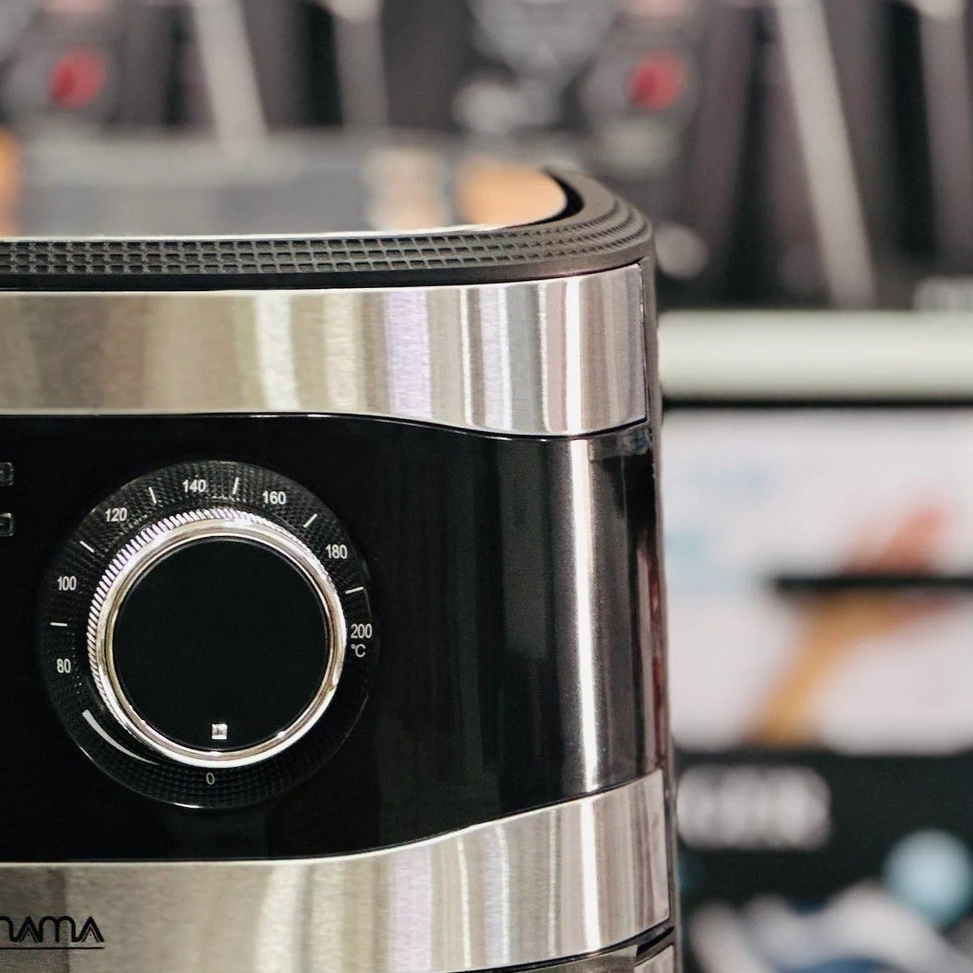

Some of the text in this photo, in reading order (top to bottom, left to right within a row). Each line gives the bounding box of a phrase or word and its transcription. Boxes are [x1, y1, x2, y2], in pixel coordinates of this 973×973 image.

[182, 479, 207, 493] 140
[262, 491, 287, 505] 160
[105, 508, 127, 522] 120
[325, 544, 348, 559] 180
[57, 576, 77, 591] 100
[350, 624, 373, 639] 200
[56, 659, 72, 674] 80
[205, 772, 216, 786] 0
